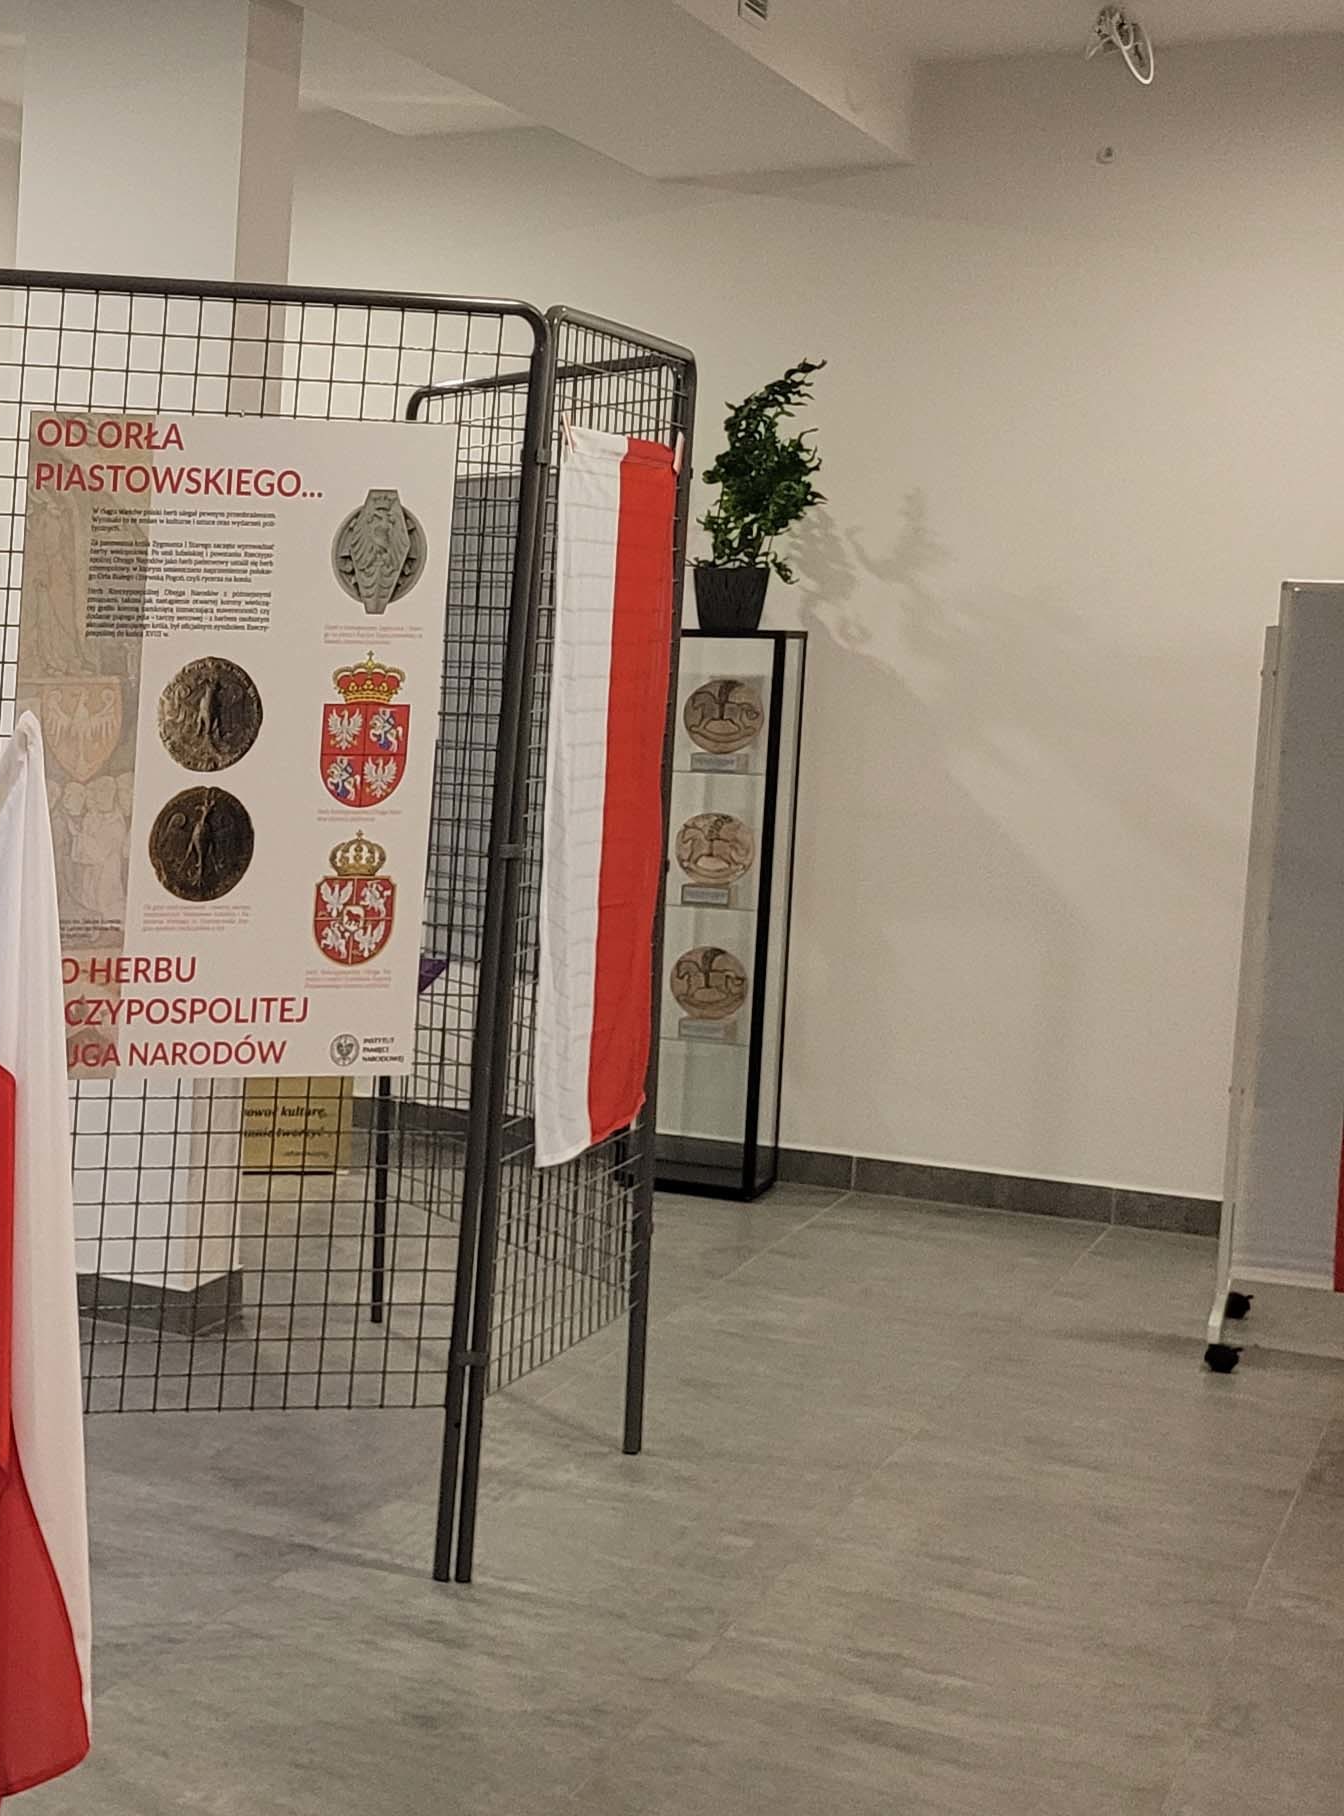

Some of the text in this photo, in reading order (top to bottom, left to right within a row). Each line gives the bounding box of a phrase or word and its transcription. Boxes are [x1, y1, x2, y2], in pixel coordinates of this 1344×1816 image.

[37, 418, 185, 451] OD ORŁA
[35, 462, 324, 499] PIASTOWSKIEGO...
[61, 956, 197, 985] O HERBU
[64, 997, 309, 1026] CZYPOSPOLITEJ
[68, 1034, 288, 1068] JGA NARODÓW
